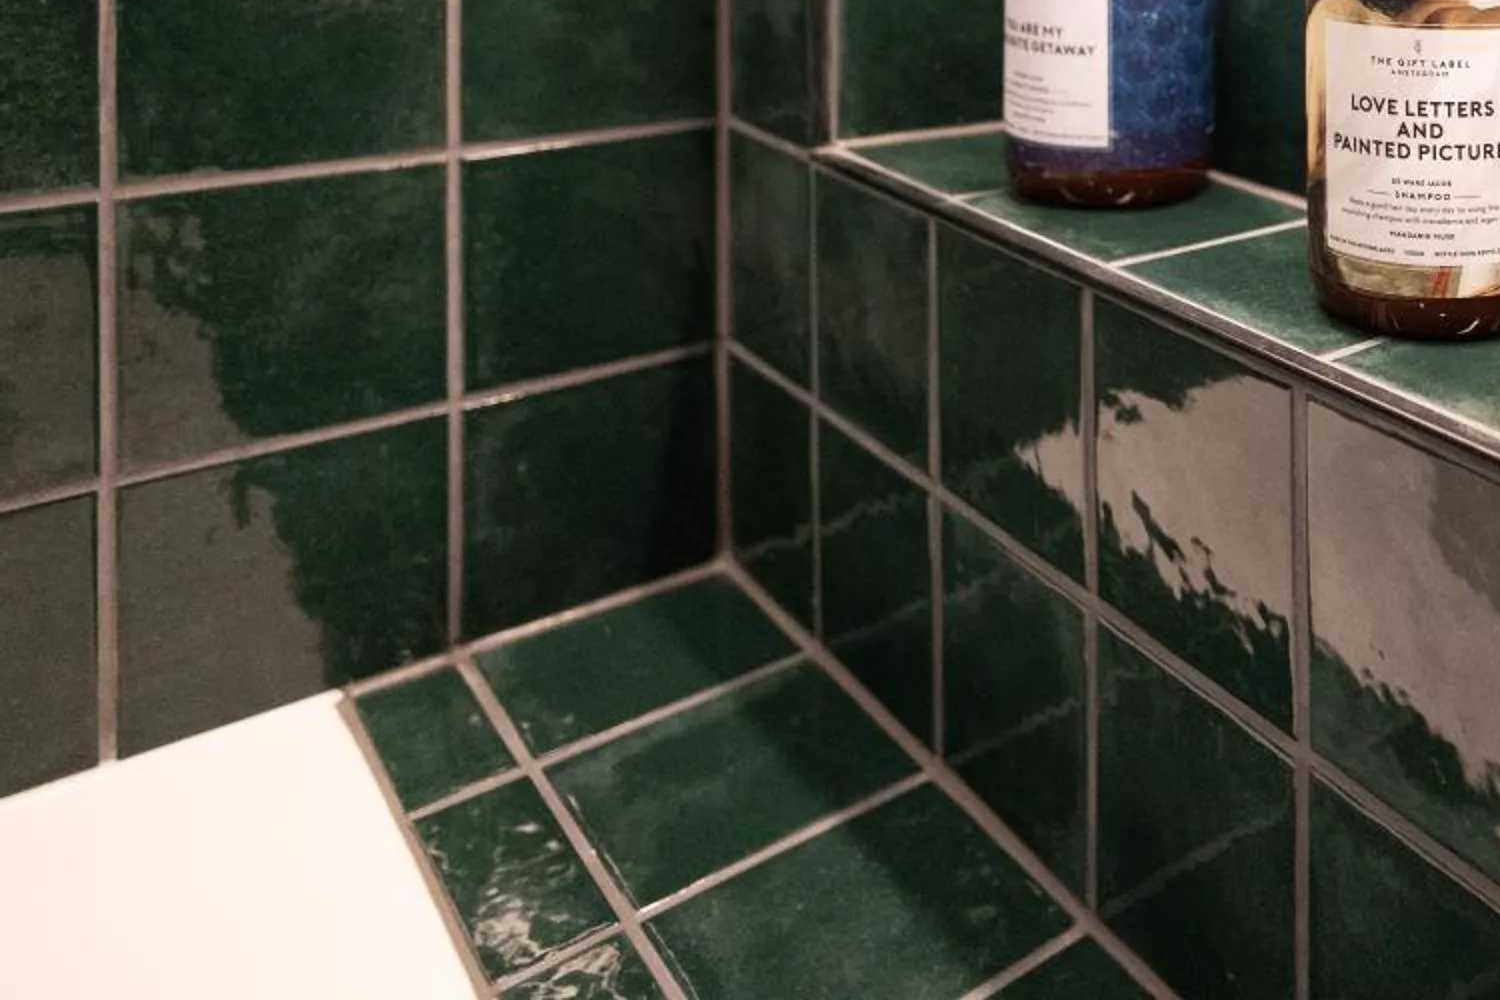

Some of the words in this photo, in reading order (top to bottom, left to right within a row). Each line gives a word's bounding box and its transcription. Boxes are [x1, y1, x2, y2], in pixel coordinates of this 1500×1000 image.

[1021, 22, 1039, 36] ARE
[1042, 25, 1062, 40] MY
[1031, 40, 1097, 56] GETAWAY
[1371, 56, 1392, 66] THE
[1397, 59, 1426, 68] GIFT
[1432, 60, 1471, 69] LABEL
[1351, 94, 1398, 115] LOVE
[1405, 100, 1495, 118] LETTERS
[1397, 123, 1443, 139] AND
[1334, 132, 1411, 159] PAINTED
[1395, 190, 1451, 201] SHAMPOO
